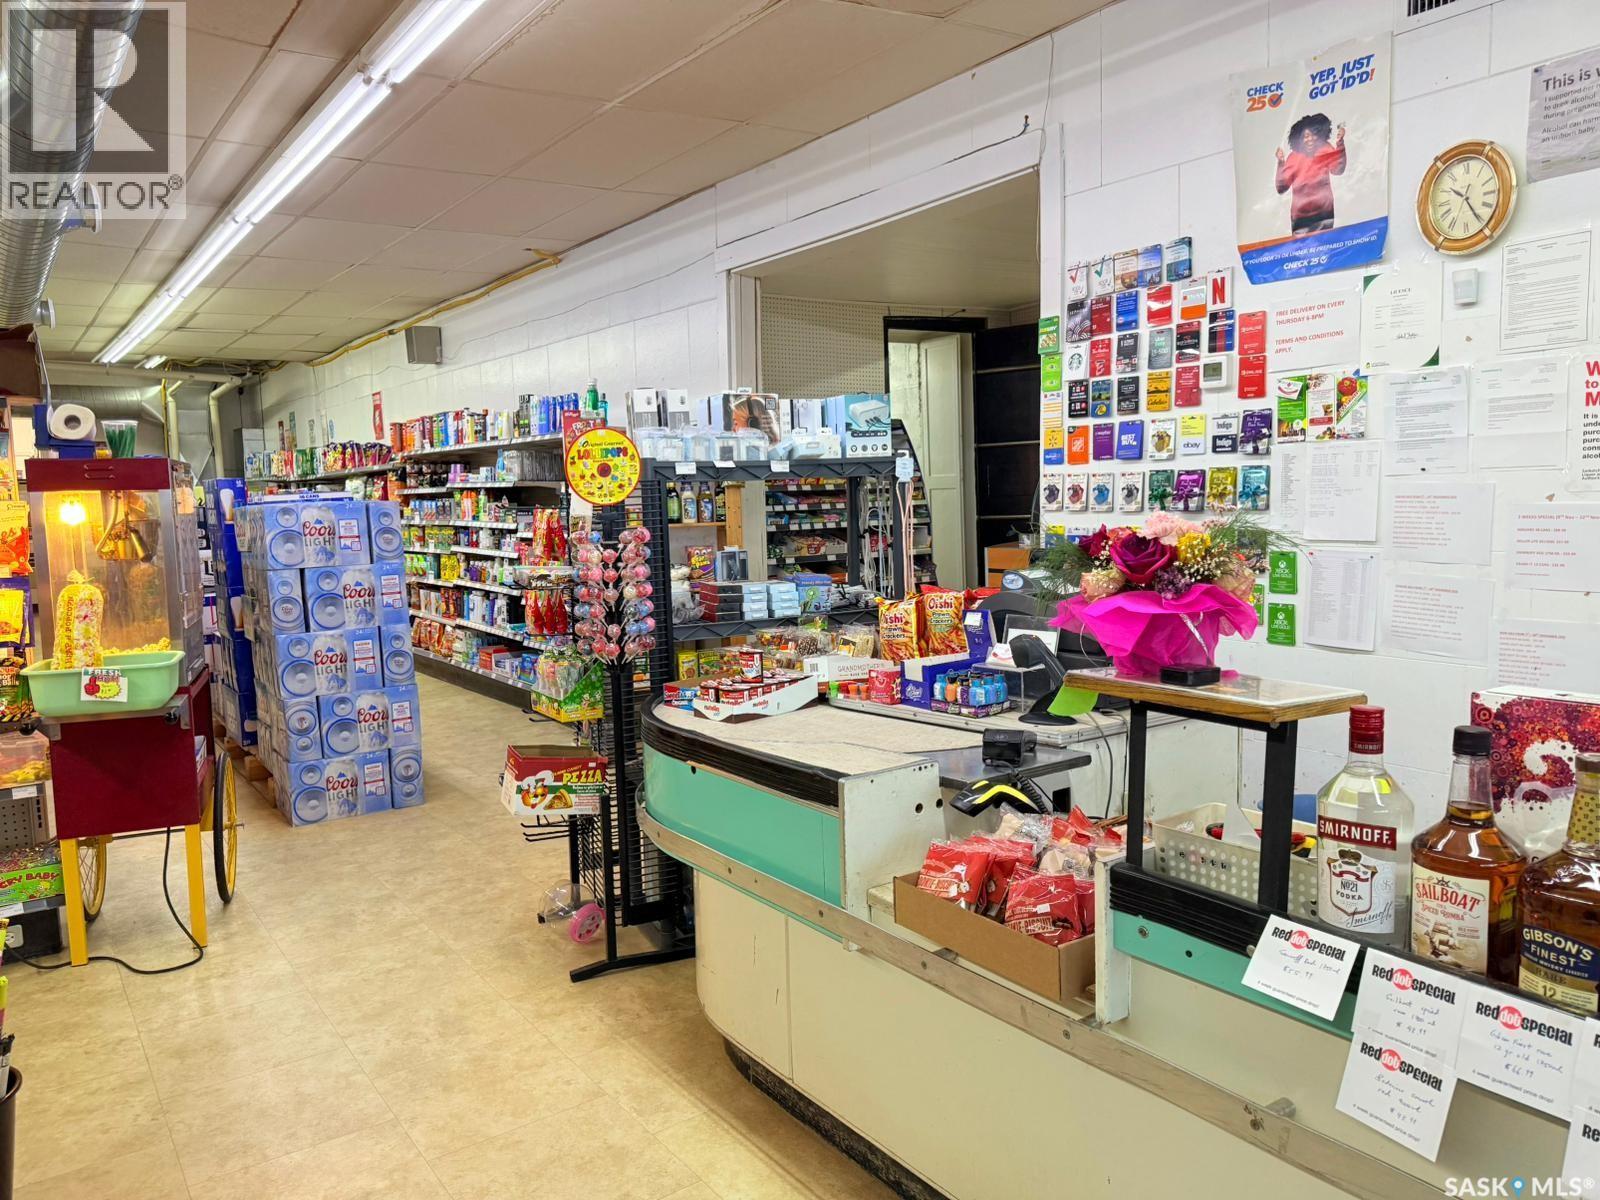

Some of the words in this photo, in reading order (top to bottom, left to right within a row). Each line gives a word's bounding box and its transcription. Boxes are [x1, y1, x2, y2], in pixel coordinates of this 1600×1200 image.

[1310, 67, 1337, 86] YEP,
[1340, 53, 1375, 79] JUST
[1309, 80, 1338, 100] GOT
[1341, 68, 1375, 91] ID'D!
[1542, 72, 1575, 91] This
[1579, 68, 1592, 82] is
[1247, 81, 1284, 97] CHECK
[1247, 95, 1266, 112] 25
[1570, 92, 1596, 105] alcohol
[1283, 260, 1309, 271] CHECK
[1212, 276, 1226, 306] N
[1290, 304, 1316, 315] DELIVERY
[1327, 300, 1345, 308] EVERY
[1276, 317, 1305, 326] THURSDAY
[1275, 338, 1294, 346] TERMS
[1294, 335, 1308, 343] AND
[1309, 330, 1344, 341] CONDITIONS
[577, 446, 628, 460] LOLLIPOPS
[927, 597, 954, 611] Oishi
[562, 768, 603, 785] PIZZA
[1319, 819, 1389, 844] SMIRNOFF
[26, 871, 60, 881] BABY
[1336, 889, 1364, 901] VODKA
[1415, 882, 1481, 912] SAILBOAT
[1522, 927, 1595, 962] GIBSON'S
[1530, 944, 1577, 968] FINEST
[1542, 984, 1558, 999] 12
